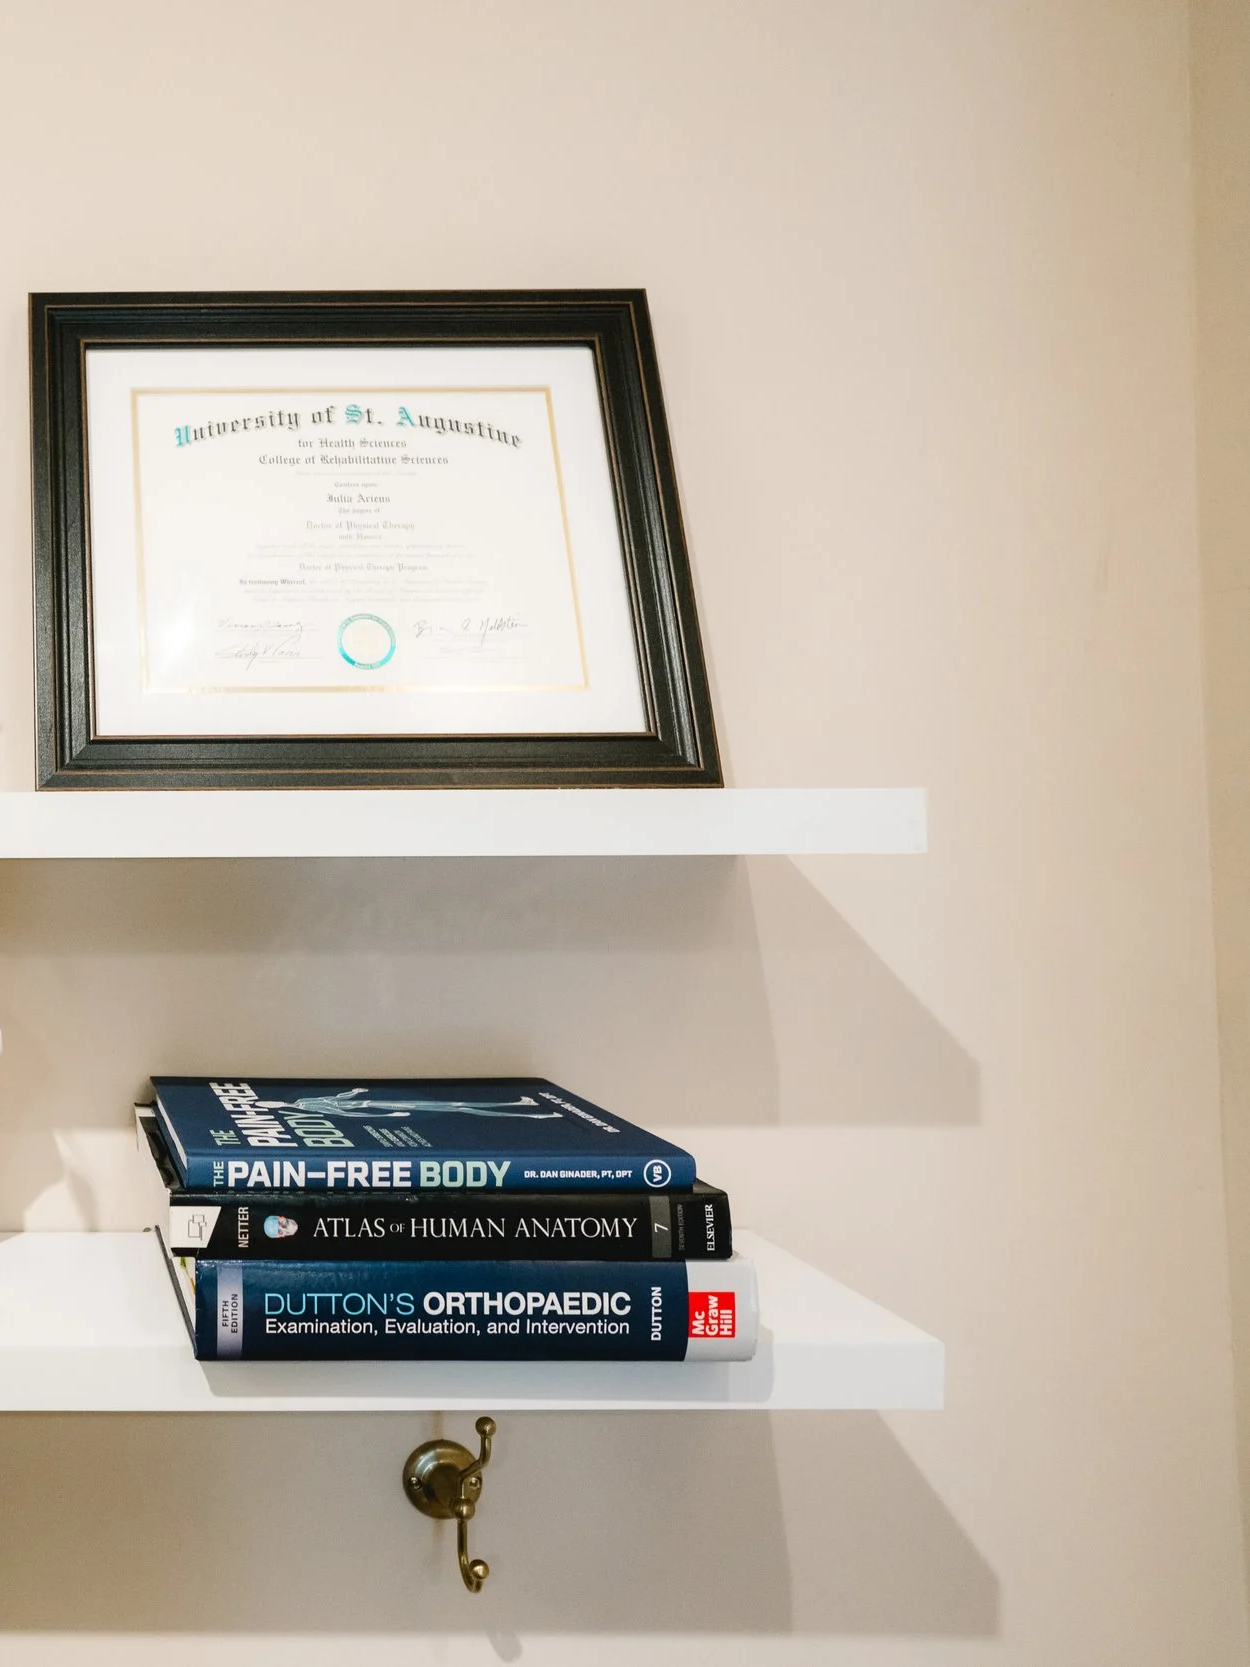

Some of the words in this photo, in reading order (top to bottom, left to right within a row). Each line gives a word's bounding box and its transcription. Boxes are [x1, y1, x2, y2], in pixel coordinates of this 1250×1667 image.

[174, 409, 299, 448] University
[311, 405, 336, 424] of
[344, 404, 383, 424] St.
[396, 406, 522, 448] Augustine
[298, 438, 314, 448] for
[318, 438, 355, 450] Health
[359, 438, 407, 448] Sciences
[258, 454, 301, 466] College
[305, 454, 316, 465] of
[320, 454, 397, 466] Rehabilitative
[401, 454, 449, 465] Sciences
[326, 493, 352, 503] Julia
[346, 520, 380, 532] Physical
[382, 520, 415, 532] Therapy
[209, 1082, 299, 1147] PAIN-FREE
[209, 1129, 241, 1146] THE
[278, 1110, 355, 1148] BODY
[213, 1161, 225, 1187] THE
[228, 1160, 412, 1188] PAIN-FREE
[419, 1160, 511, 1188] BODY
[524, 1170, 539, 1179] DR.
[540, 1170, 558, 1179] DAN
[559, 1170, 600, 1181] GINADER,
[601, 1170, 614, 1181] PT,
[616, 1170, 633, 1179] DPT
[237, 1206, 249, 1248] NETTER
[313, 1217, 386, 1239] ATLAS
[410, 1217, 505, 1239] HUMAN
[514, 1217, 638, 1239] ANATOMY
[654, 1222, 669, 1233] 7
[705, 1204, 716, 1251] ELSEVIER
[221, 1300, 230, 1328] FIFTH
[231, 1293, 239, 1334] EDITION
[264, 1293, 415, 1315] DUTTON'S
[423, 1291, 632, 1316] ORTHOPAEDIC
[650, 1286, 663, 1341] DUTTON
[705, 1295, 719, 1336] Graw
[265, 1318, 378, 1336] Examination,
[384, 1318, 481, 1336] Evaluation,
[486, 1318, 520, 1335] and
[526, 1318, 630, 1335] Intervention
[691, 1311, 705, 1336] Mc
[719, 1309, 733, 1336] Hill
